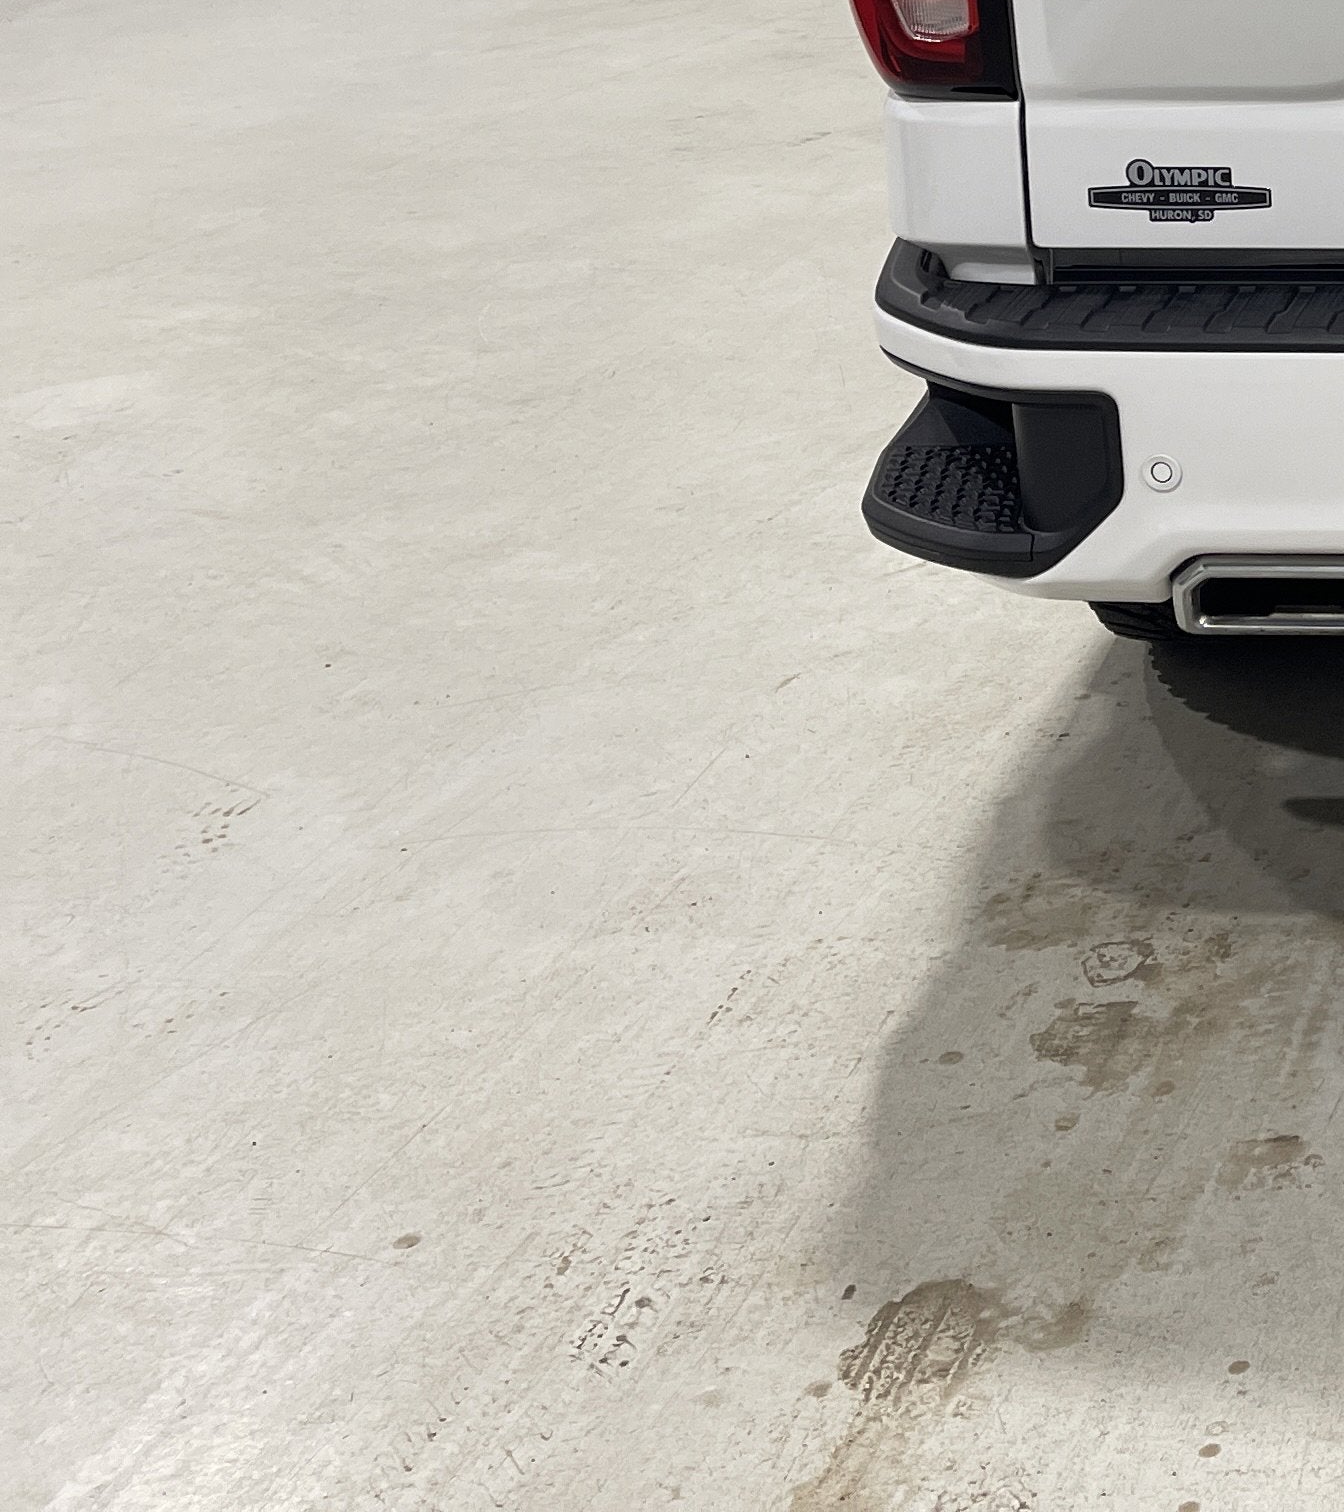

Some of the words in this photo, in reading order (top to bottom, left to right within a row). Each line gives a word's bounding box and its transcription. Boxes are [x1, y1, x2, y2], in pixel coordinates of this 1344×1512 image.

[1127, 161, 1231, 186] OLYMPIC
[1121, 192, 1155, 203] CHEVY
[1169, 192, 1200, 203] BUICK
[1215, 193, 1239, 203] GMC
[1151, 210, 1196, 221] HURON,
[1198, 210, 1213, 220] SD
